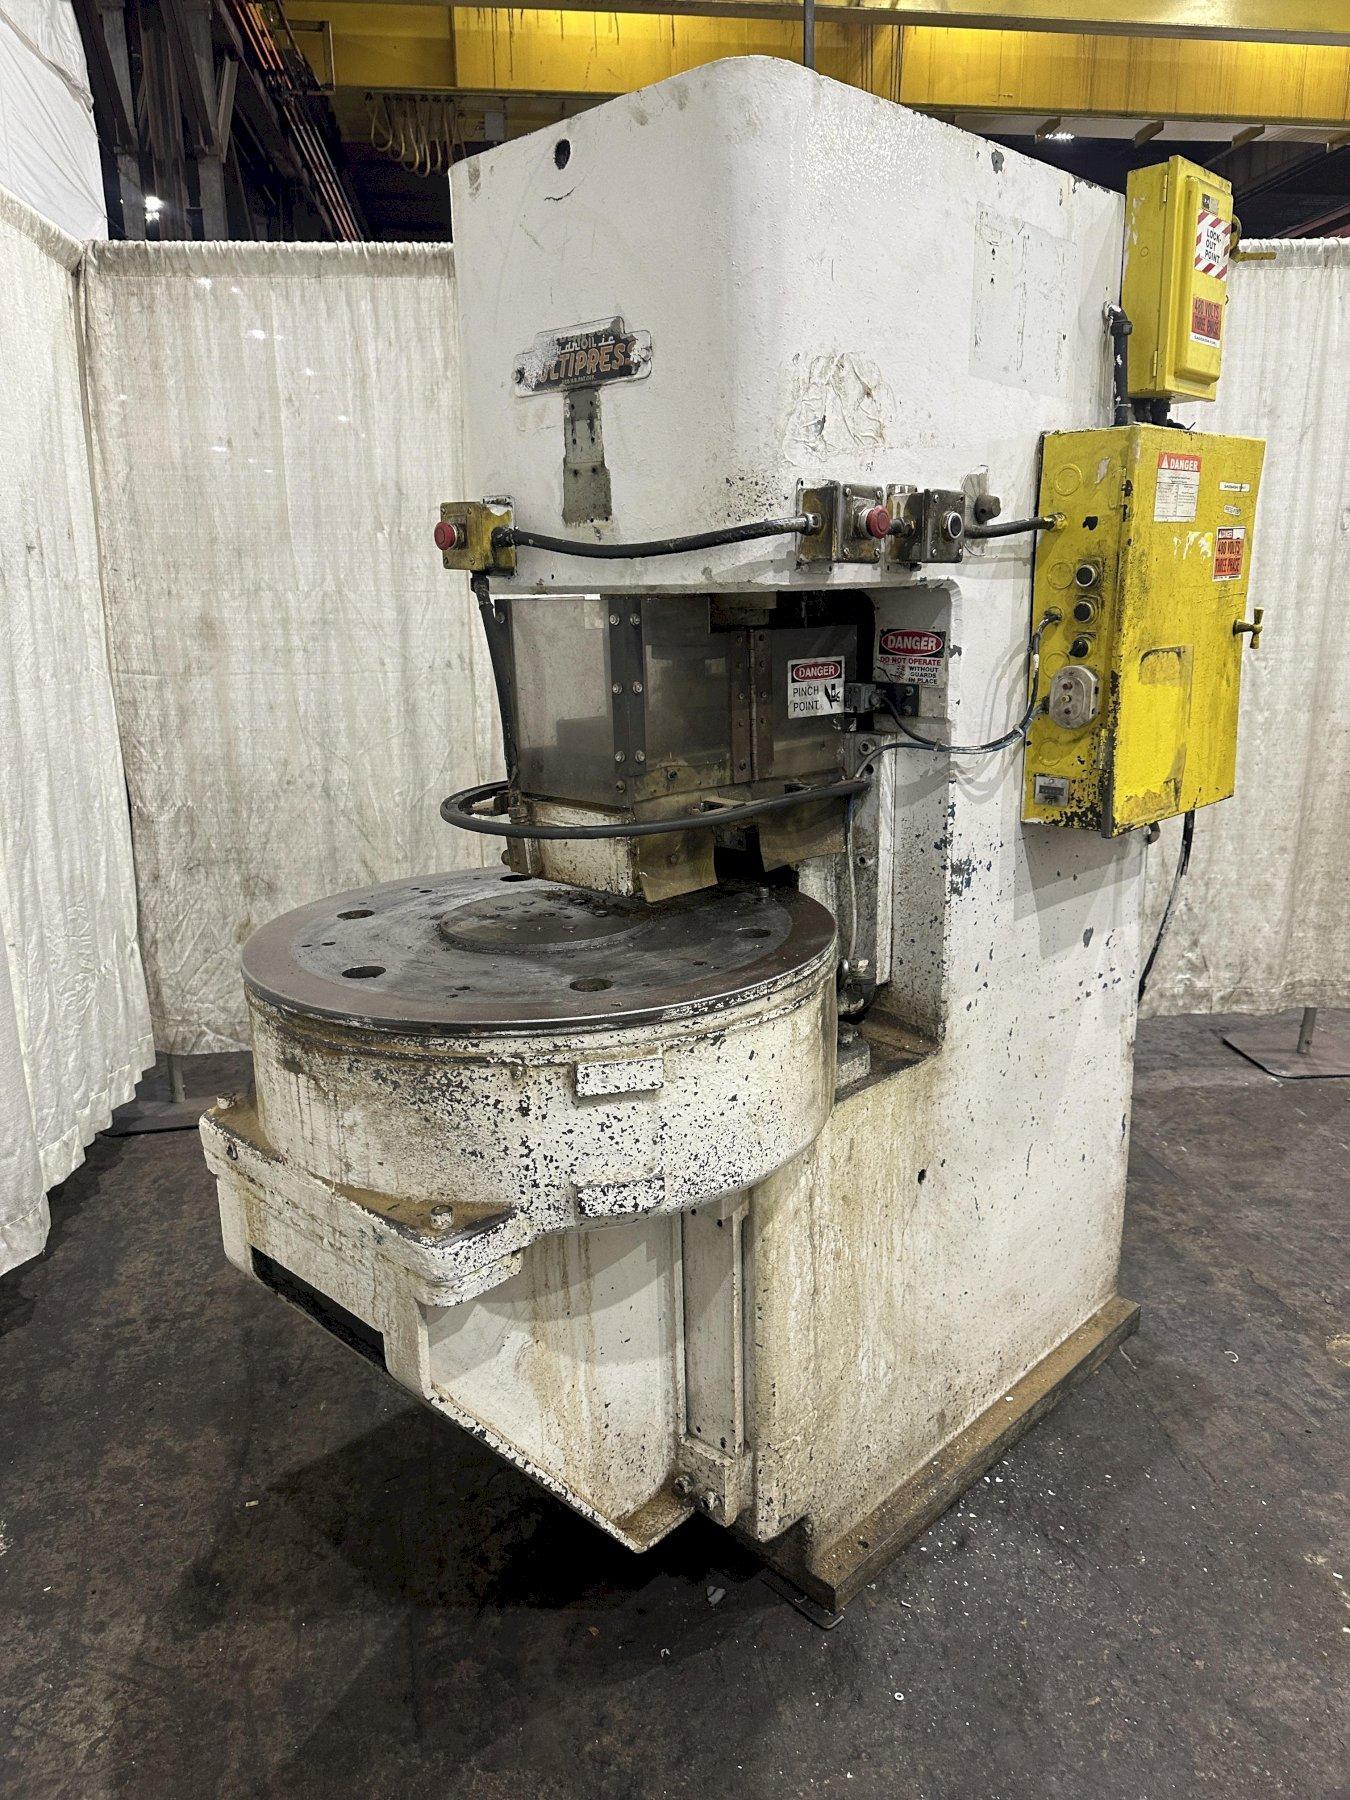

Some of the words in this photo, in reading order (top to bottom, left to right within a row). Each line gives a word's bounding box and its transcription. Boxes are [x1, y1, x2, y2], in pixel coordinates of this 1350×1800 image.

[1207, 229, 1221, 243] LOCK-
[1205, 239, 1217, 251] OUT
[1204, 250, 1220, 263] POINT
[1205, 301, 1219, 319] VOLTS
[1170, 458, 1198, 472] DANGER
[1217, 541, 1226, 555] 480
[1227, 541, 1240, 555] VOLTS
[1215, 558, 1226, 572] THREE
[1227, 557, 1240, 572] PHASE
[887, 635, 937, 651] DANGER
[880, 656, 889, 664] DO
[891, 656, 906, 664] NOT
[908, 658, 941, 666] OPERATE
[799, 665, 835, 678] DANGER
[909, 665, 939, 673] WITHOUT
[793, 685, 819, 698] PINCH
[793, 700, 820, 713] POINT
